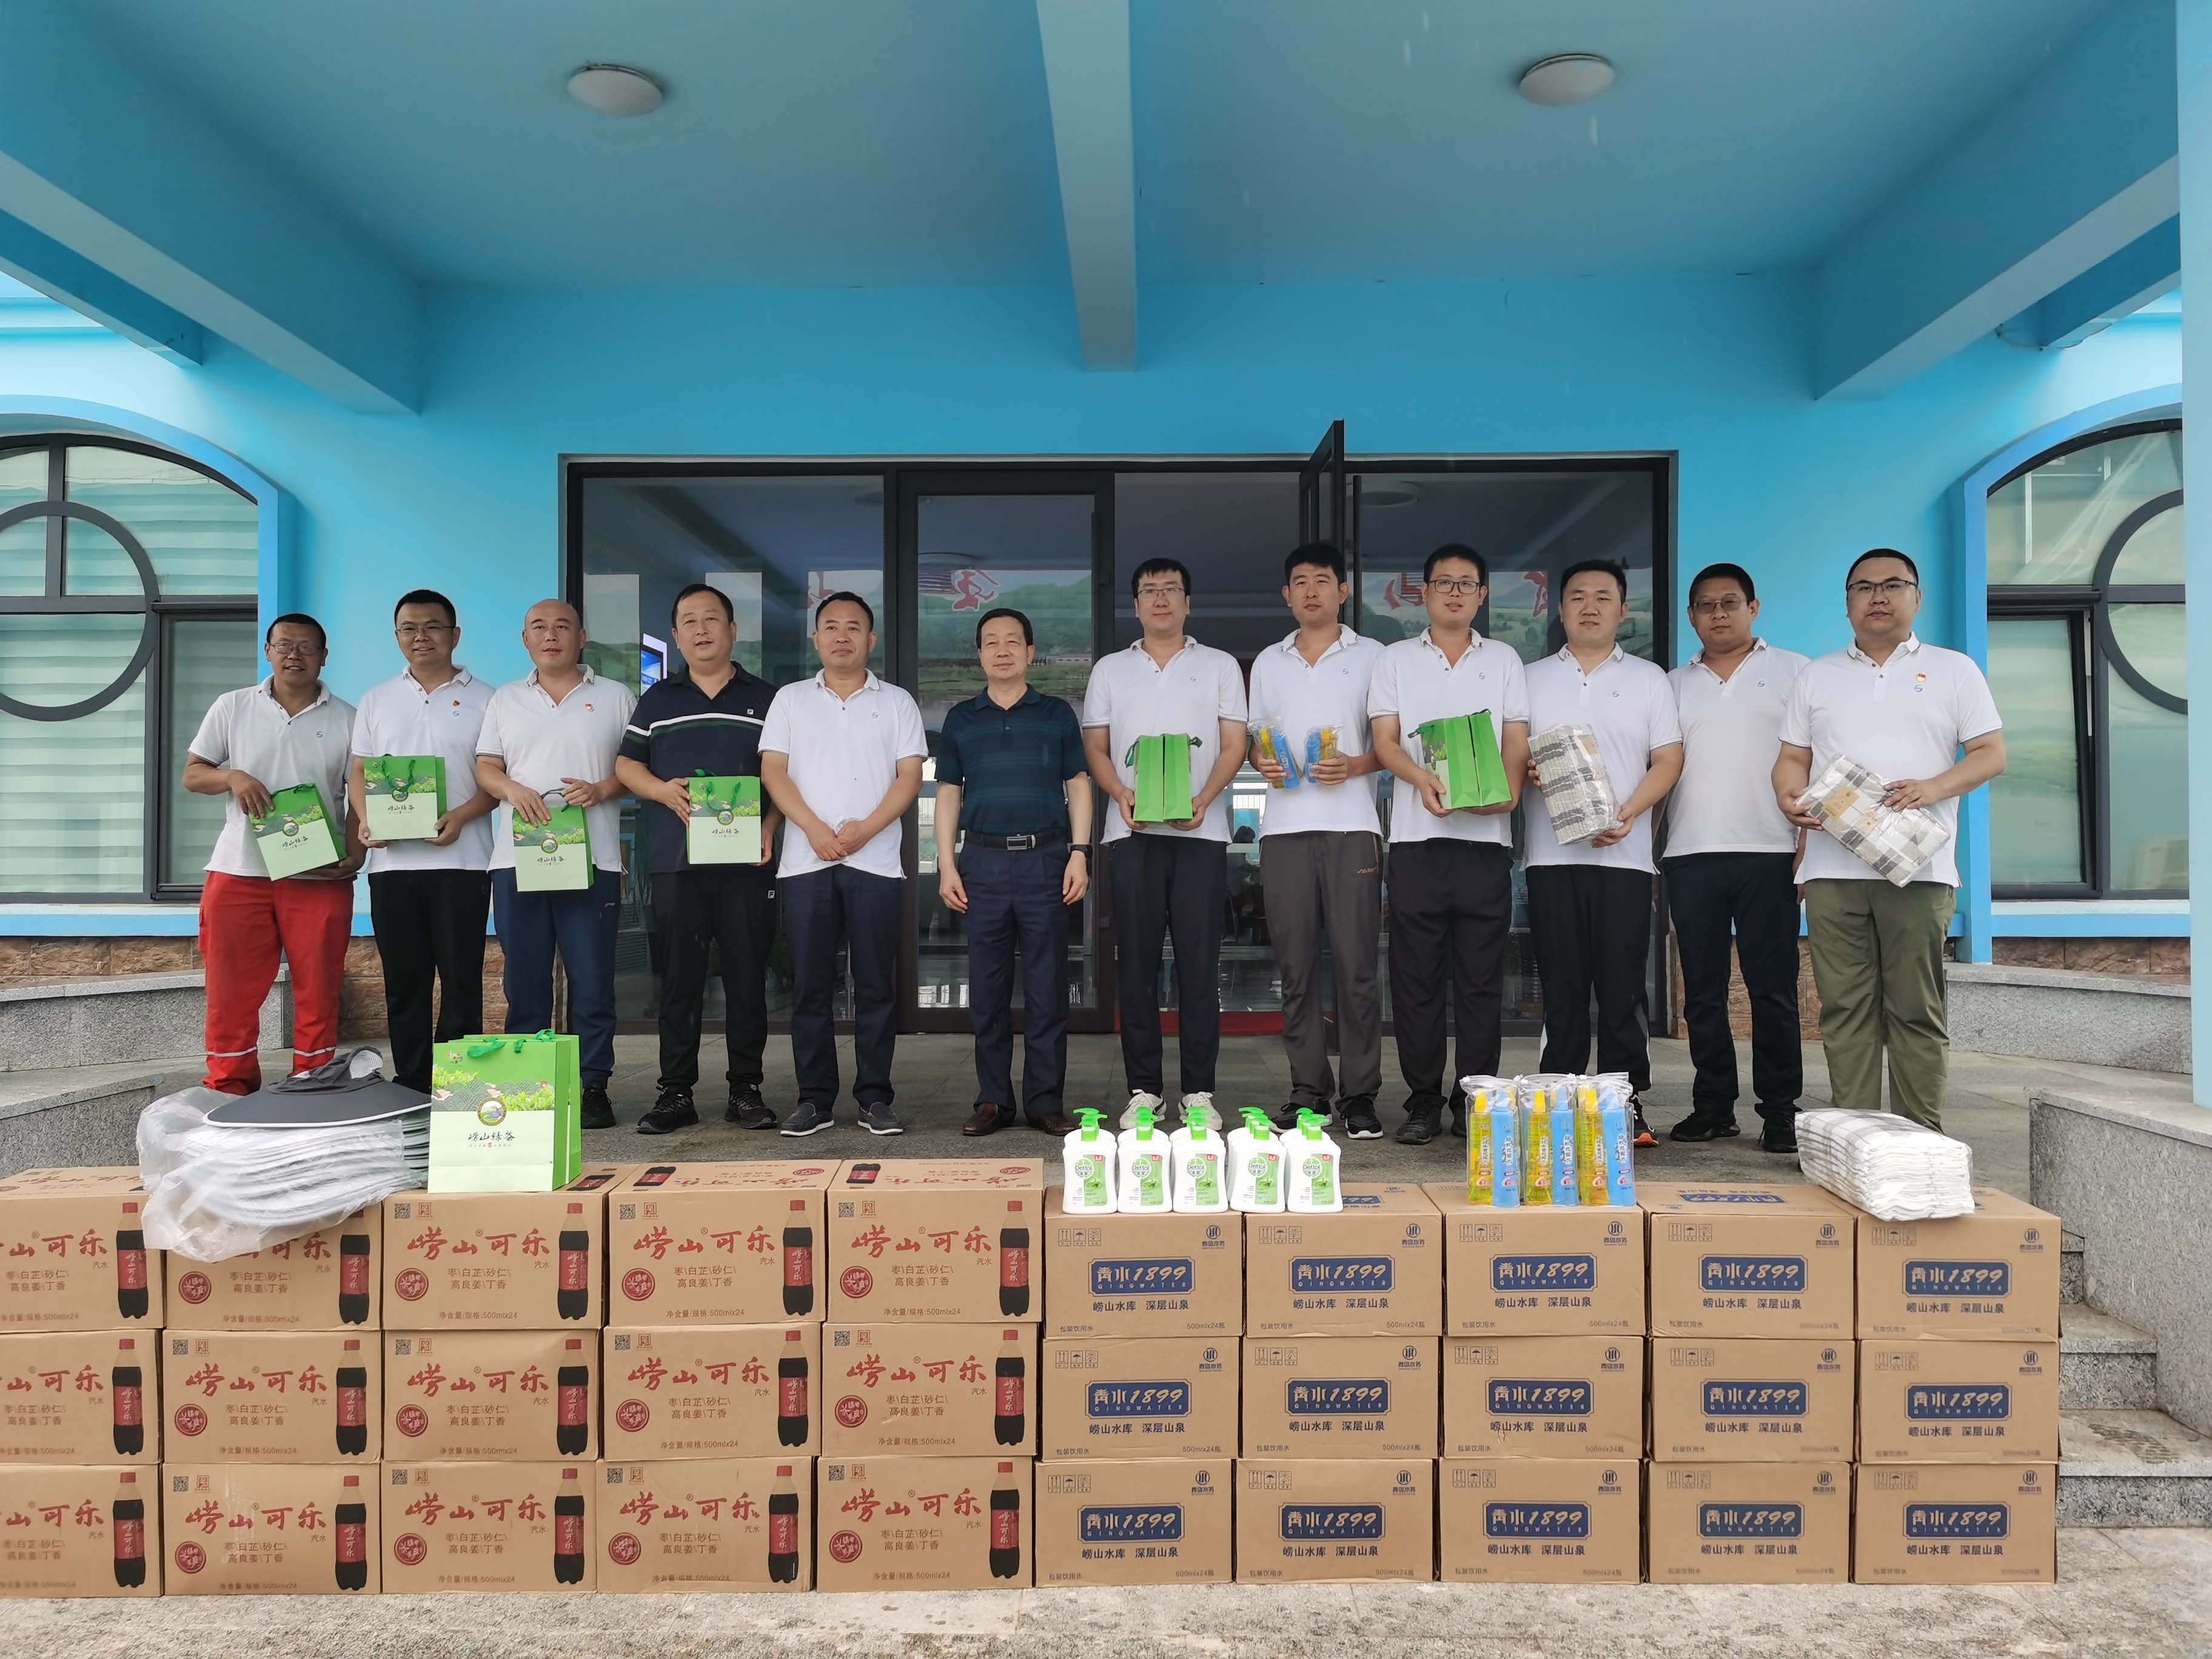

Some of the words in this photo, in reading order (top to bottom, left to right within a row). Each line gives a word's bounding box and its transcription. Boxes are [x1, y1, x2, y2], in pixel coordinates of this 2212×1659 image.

[0, 1228, 108, 1258] 山可乐
[407, 1226, 551, 1261] 崂山可乐
[633, 1225, 775, 1259] 崂山可乐
[851, 1224, 992, 1258] 崂山可乐
[674, 1265, 737, 1276] 枣\白芷\砂仁\
[891, 1264, 954, 1275] 枣\白芷\砂仁\
[1097, 1266, 1187, 1282] 青水1899
[1297, 1264, 1387, 1280] 青水1899
[1498, 1262, 1589, 1278] 青水1899
[451, 1279, 507, 1290] 高良姜\丁香
[678, 1278, 733, 1288] 高良姜\丁香
[895, 1276, 950, 1287] 高良姜\丁香
[1093, 1300, 1137, 1312] 崂山水库
[1145, 1299, 1190, 1310] 深层山泉
[1293, 1298, 1337, 1310] 崂山水库
[1346, 1298, 1390, 1309] 深层山泉
[1495, 1296, 1539, 1308] 崂山水库
[1548, 1296, 1592, 1307] 深层山泉
[1703, 1296, 1748, 1309] 崂山水库
[1757, 1298, 1802, 1309] 深层山泉
[1906, 1301, 1951, 1313] 崂山水库
[1960, 1302, 2006, 1313] 深层山泉
[628, 1356, 770, 1390] 崂山可乐
[846, 1353, 987, 1388] 崂山可乐
[0, 1364, 104, 1393] 山可乐
[185, 1364, 327, 1398] 崂山可乐
[407, 1364, 548, 1398] 崂山可乐
[1094, 1389, 1184, 1405] 青水1899
[1293, 1386, 1383, 1403] 青水1899
[1494, 1387, 1586, 1403] 青水1899
[672, 1409, 728, 1419] 高良姜\丁香
[890, 1406, 945, 1416] 高良姜\丁香
[451, 1416, 506, 1426] 高良姜\丁香
[1289, 1419, 1333, 1432] 崂山水库
[1342, 1420, 1386, 1431] 深层山泉
[1490, 1420, 1535, 1432] 崂山水库
[1544, 1421, 1589, 1432] 深层山泉
[1704, 1421, 1749, 1433] 崂山水库
[1758, 1422, 1803, 1433] 深层山泉
[1089, 1423, 1133, 1435] 崂山水库
[1142, 1422, 1186, 1433] 深层山泉
[1908, 1425, 1952, 1437] 崂山水库
[1962, 1426, 2006, 1436] 深层山泉
[405, 1492, 546, 1526] 崂山可乐
[620, 1492, 760, 1526] 崂山可乐
[841, 1487, 982, 1522] 崂山可乐
[0, 1499, 104, 1527] 山可乐
[185, 1500, 326, 1535] 崂山可乐
[1287, 1511, 1378, 1527] 青水1899
[1492, 1510, 1583, 1526] 青水1899
[1086, 1513, 1176, 1529] 青水1899
[660, 1532, 722, 1542] 枣\白芷\砂仁\
[663, 1544, 718, 1554] 高良姜\丁香
[1082, 1547, 1126, 1560] 崂山水库
[1135, 1547, 1179, 1558] 深层山泉
[1282, 1545, 1327, 1557] 崂山水库
[1336, 1546, 1379, 1557] 深层山泉
[1487, 1543, 1532, 1555] 崂山水库
[1541, 1544, 1586, 1555] 深层山泉
[1700, 1543, 1745, 1555] 崂山水库
[1754, 1544, 1798, 1555] 深层山泉
[1906, 1543, 1951, 1555] 崂山水库
[1960, 1544, 2004, 1555] 深层山泉
